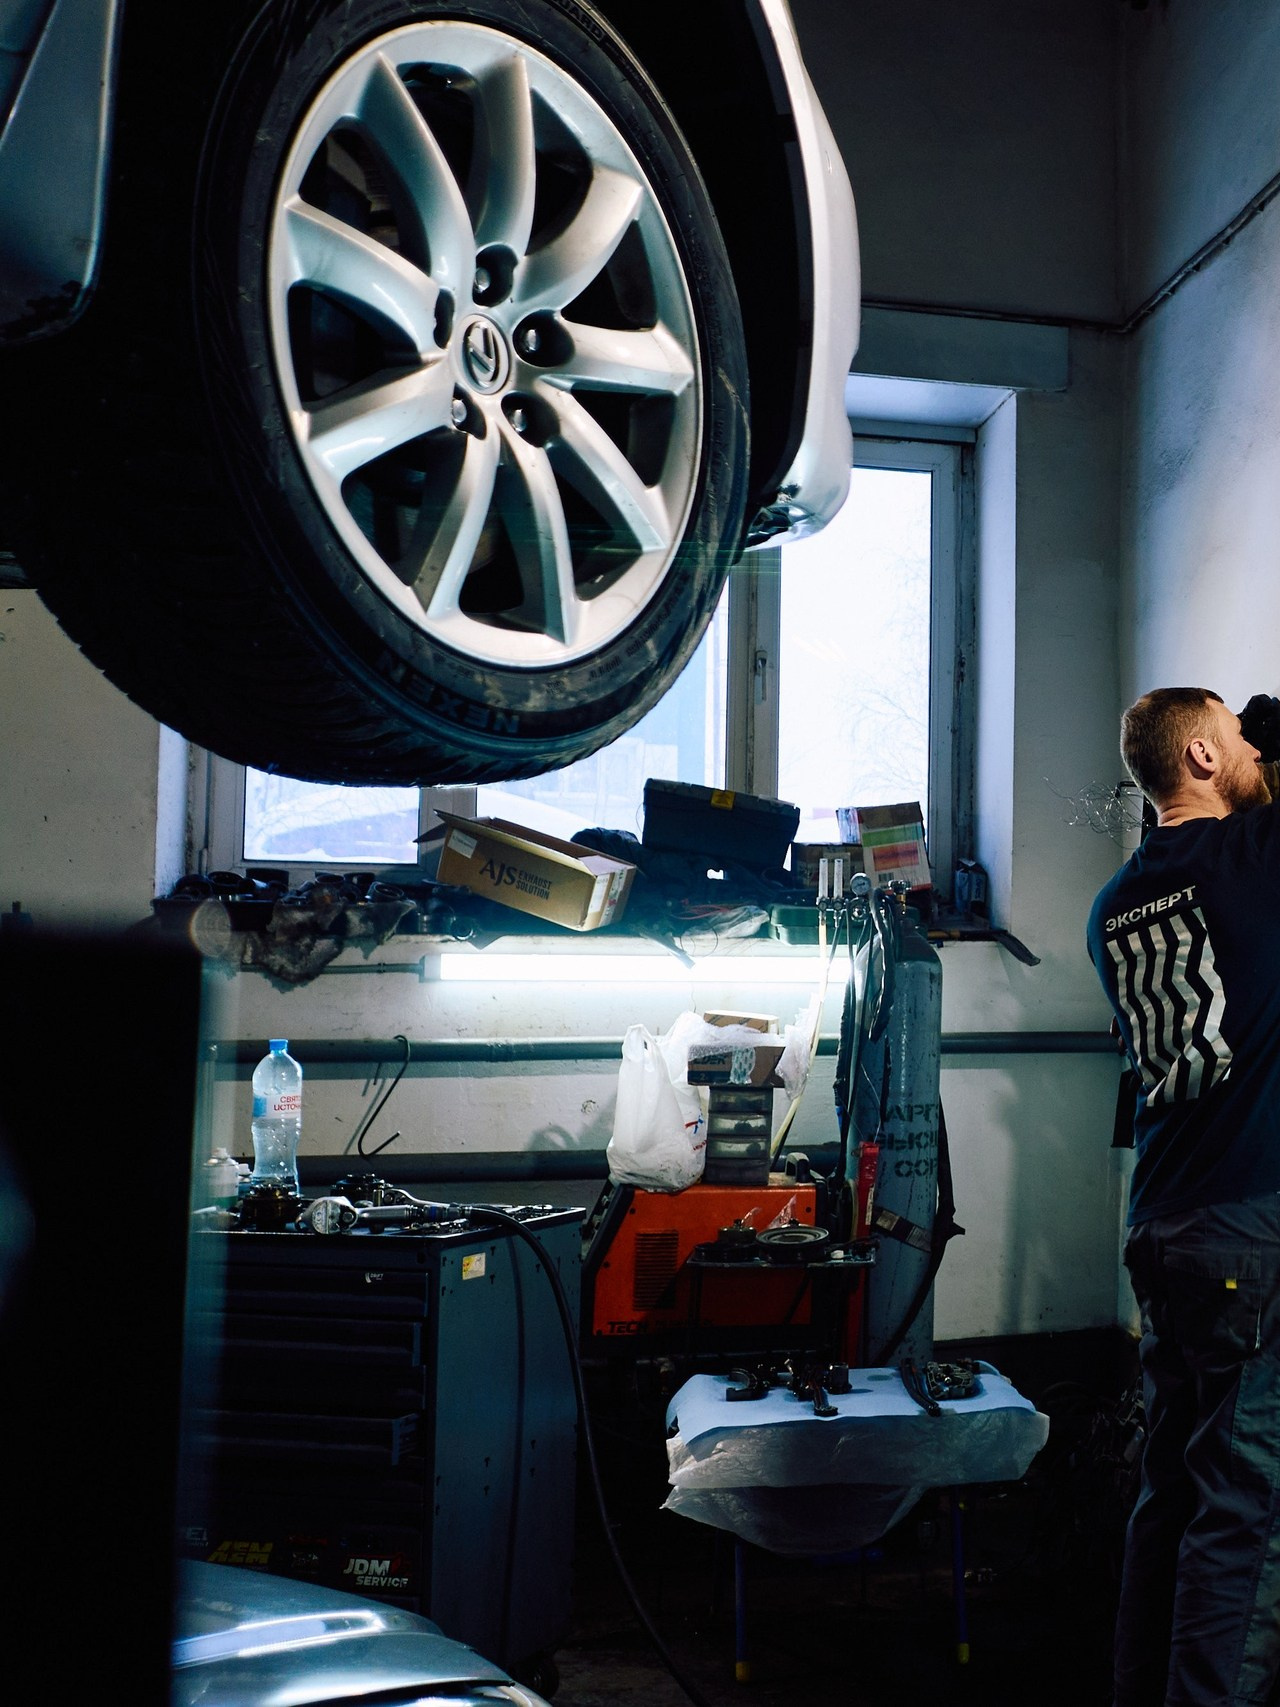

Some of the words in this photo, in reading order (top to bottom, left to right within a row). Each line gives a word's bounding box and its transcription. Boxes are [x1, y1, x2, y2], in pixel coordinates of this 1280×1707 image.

[479, 858, 518, 886] AJS
[518, 870, 553, 890] EXHAUST
[516, 879, 551, 901] SOLUTION
[1105, 885, 1196, 933] ЭКСПЕРТ
[207, 1540, 274, 1564] AEM
[343, 1558, 391, 1577] JDM
